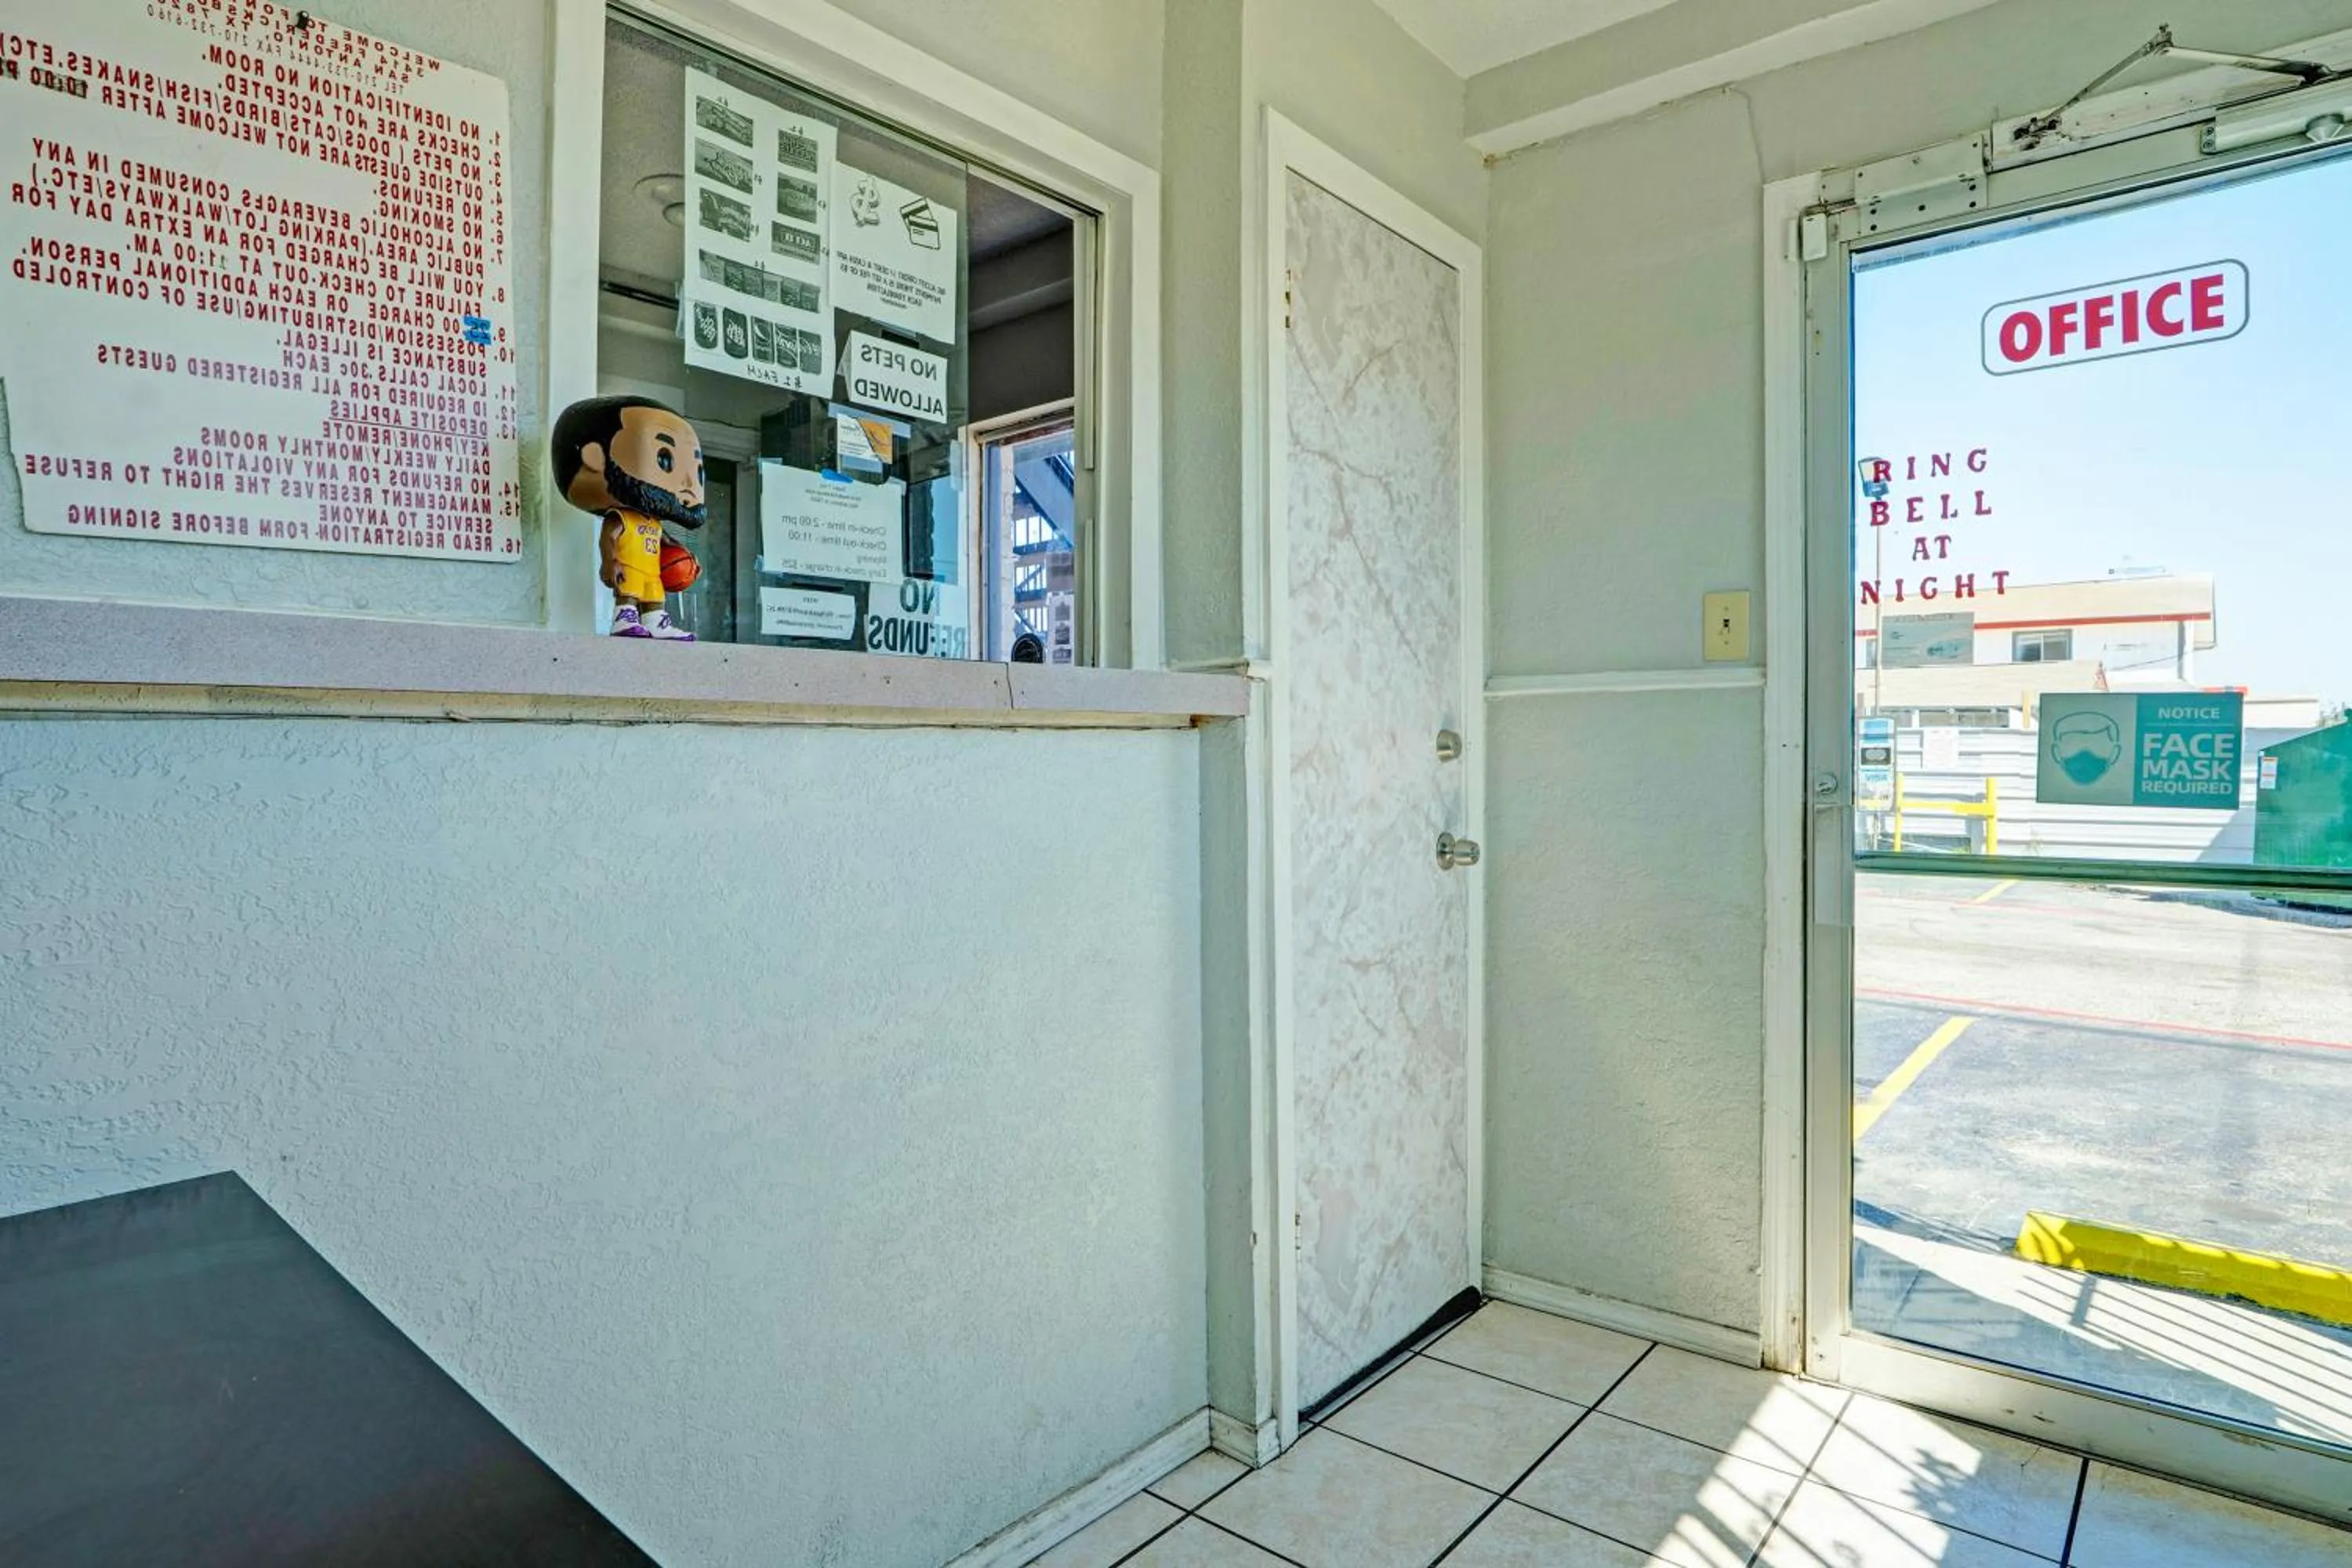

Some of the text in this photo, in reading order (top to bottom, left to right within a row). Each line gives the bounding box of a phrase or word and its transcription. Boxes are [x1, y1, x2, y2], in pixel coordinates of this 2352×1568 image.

[1998, 273, 2225, 363] OFFICE
[1872, 448, 1987, 484] RING
[1869, 489, 1992, 527] BELL
[1911, 535, 1952, 562] AT
[1860, 570, 2009, 604] NIGHT
[2158, 706, 2221, 720] NOTICE
[2143, 733, 2235, 759] FACE
[2143, 758, 2233, 780] MASK
[2141, 780, 2234, 796] REQUIRED
